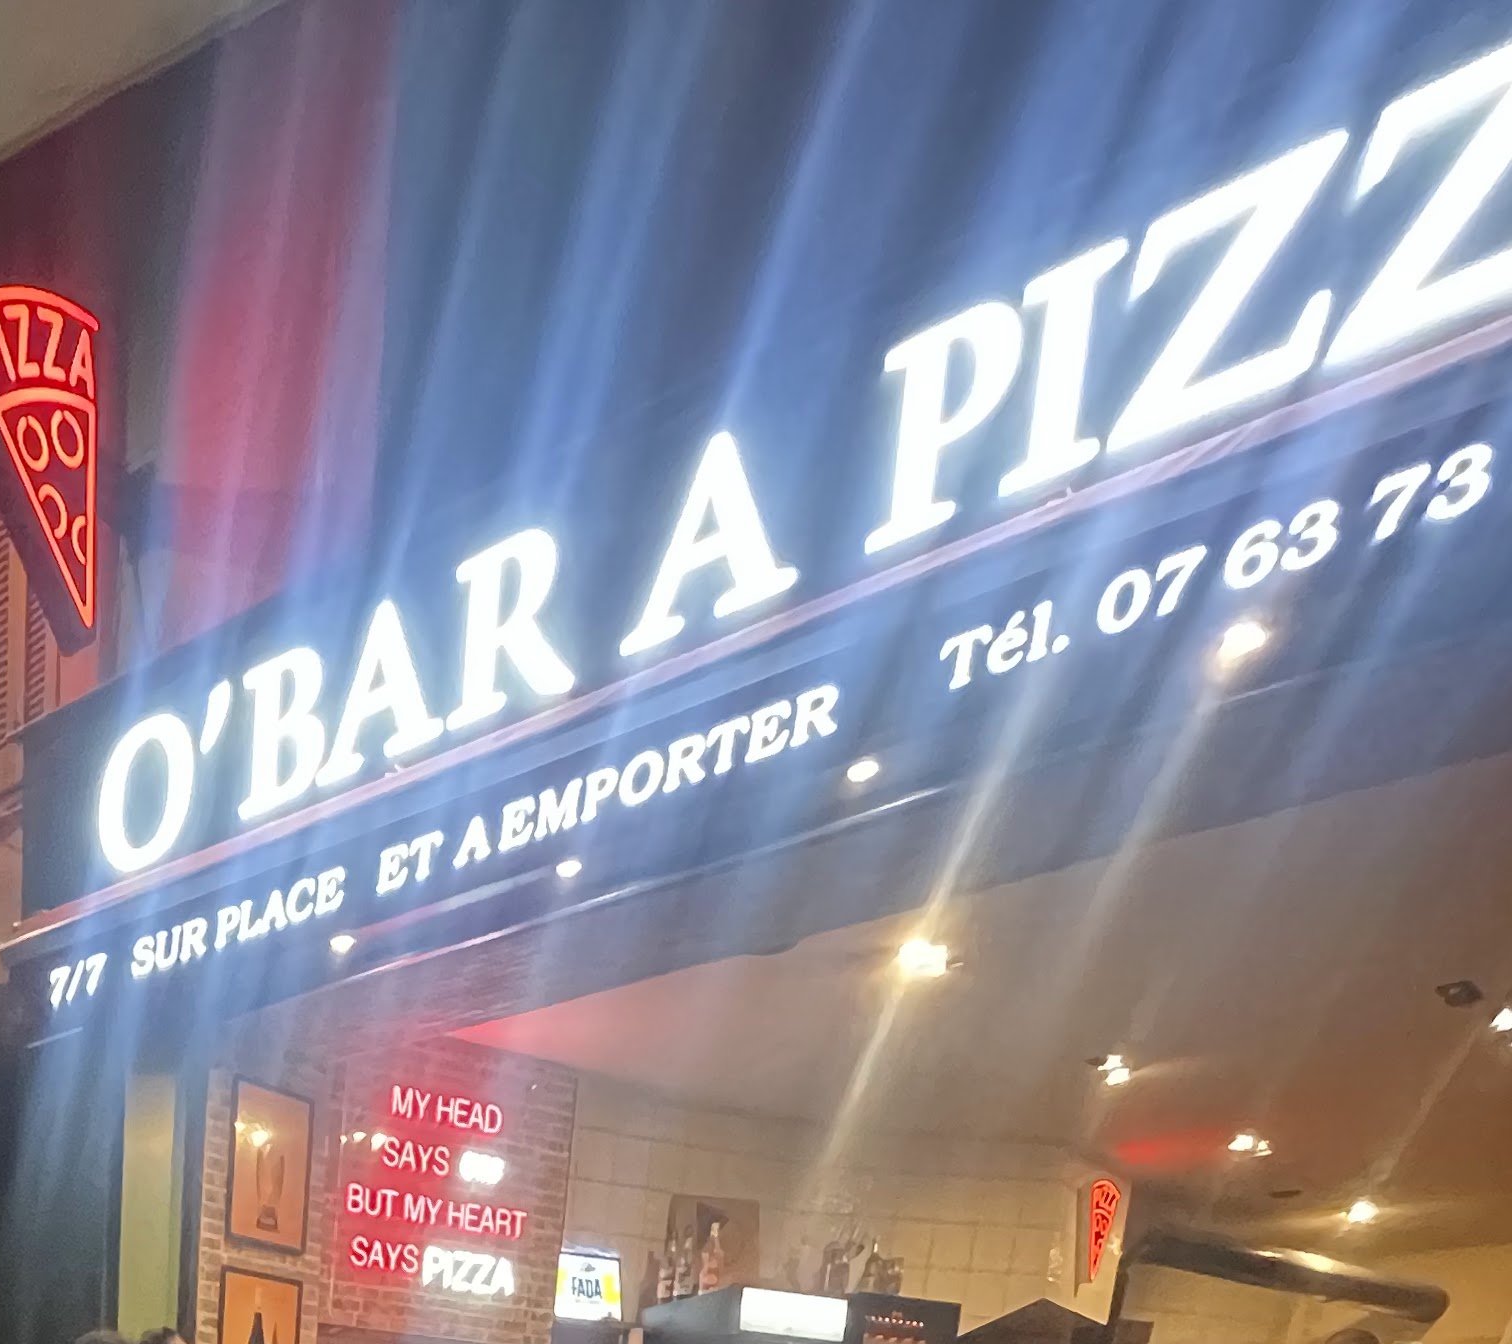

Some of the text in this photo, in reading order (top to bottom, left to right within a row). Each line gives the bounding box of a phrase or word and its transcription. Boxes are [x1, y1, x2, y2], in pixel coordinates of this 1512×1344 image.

[939, 443, 1494, 693] Tél. 07 63 73
[98, 527, 576, 874] O'BAR
[620, 431, 799, 658] A
[49, 952, 107, 1010] 7/7
[131, 916, 208, 979] SUR
[214, 866, 347, 951] PLACE
[376, 830, 444, 896] ET
[391, 1085, 503, 1133] MY HEAD
[382, 1136, 450, 1176] SAYS
[347, 1183, 527, 1238] BUT MY HEART
[350, 1235, 515, 1296] SAYS PIZZA
[571, 1276, 603, 1299] FADA
